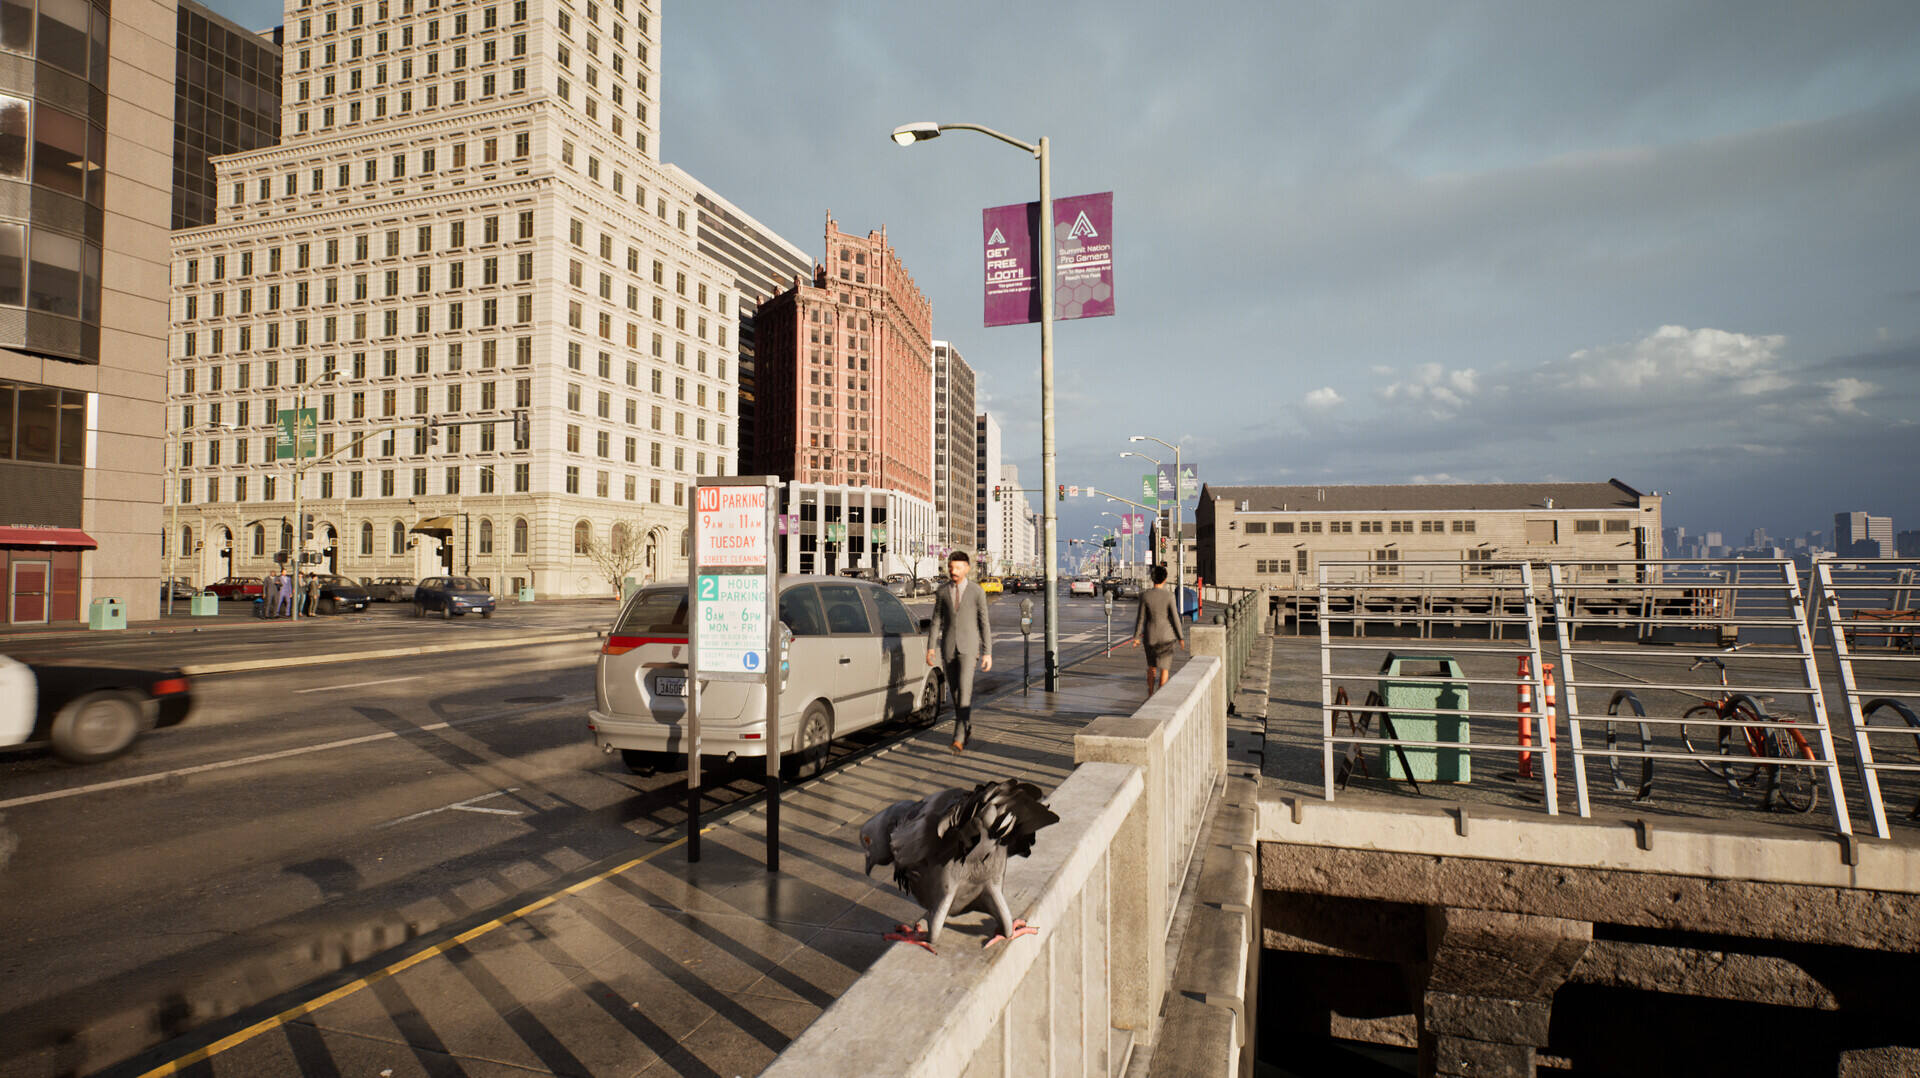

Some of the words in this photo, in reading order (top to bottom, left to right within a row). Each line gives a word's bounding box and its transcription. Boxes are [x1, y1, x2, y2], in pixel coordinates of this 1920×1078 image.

[986, 248, 1010, 258] GET
[1059, 246, 1086, 256] Summit
[1087, 244, 1111, 252] Nation
[987, 258, 1016, 270] FREE
[1060, 256, 1074, 264] Pro
[1076, 252, 1108, 262] Gamers
[987, 267, 1024, 280] LOOT!!
[700, 490, 717, 510] NO
[722, 493, 765, 508] PARKING
[710, 536, 756, 548] TUESDAY
[702, 578, 714, 598] 2
[728, 579, 758, 589] HOUR
[721, 592, 765, 602] PARKING
[705, 607, 724, 621] 8AM
[741, 608, 760, 622] 6PM
[709, 624, 728, 632] MON
[742, 624, 757, 632] FRI
[746, 654, 755, 667] L
